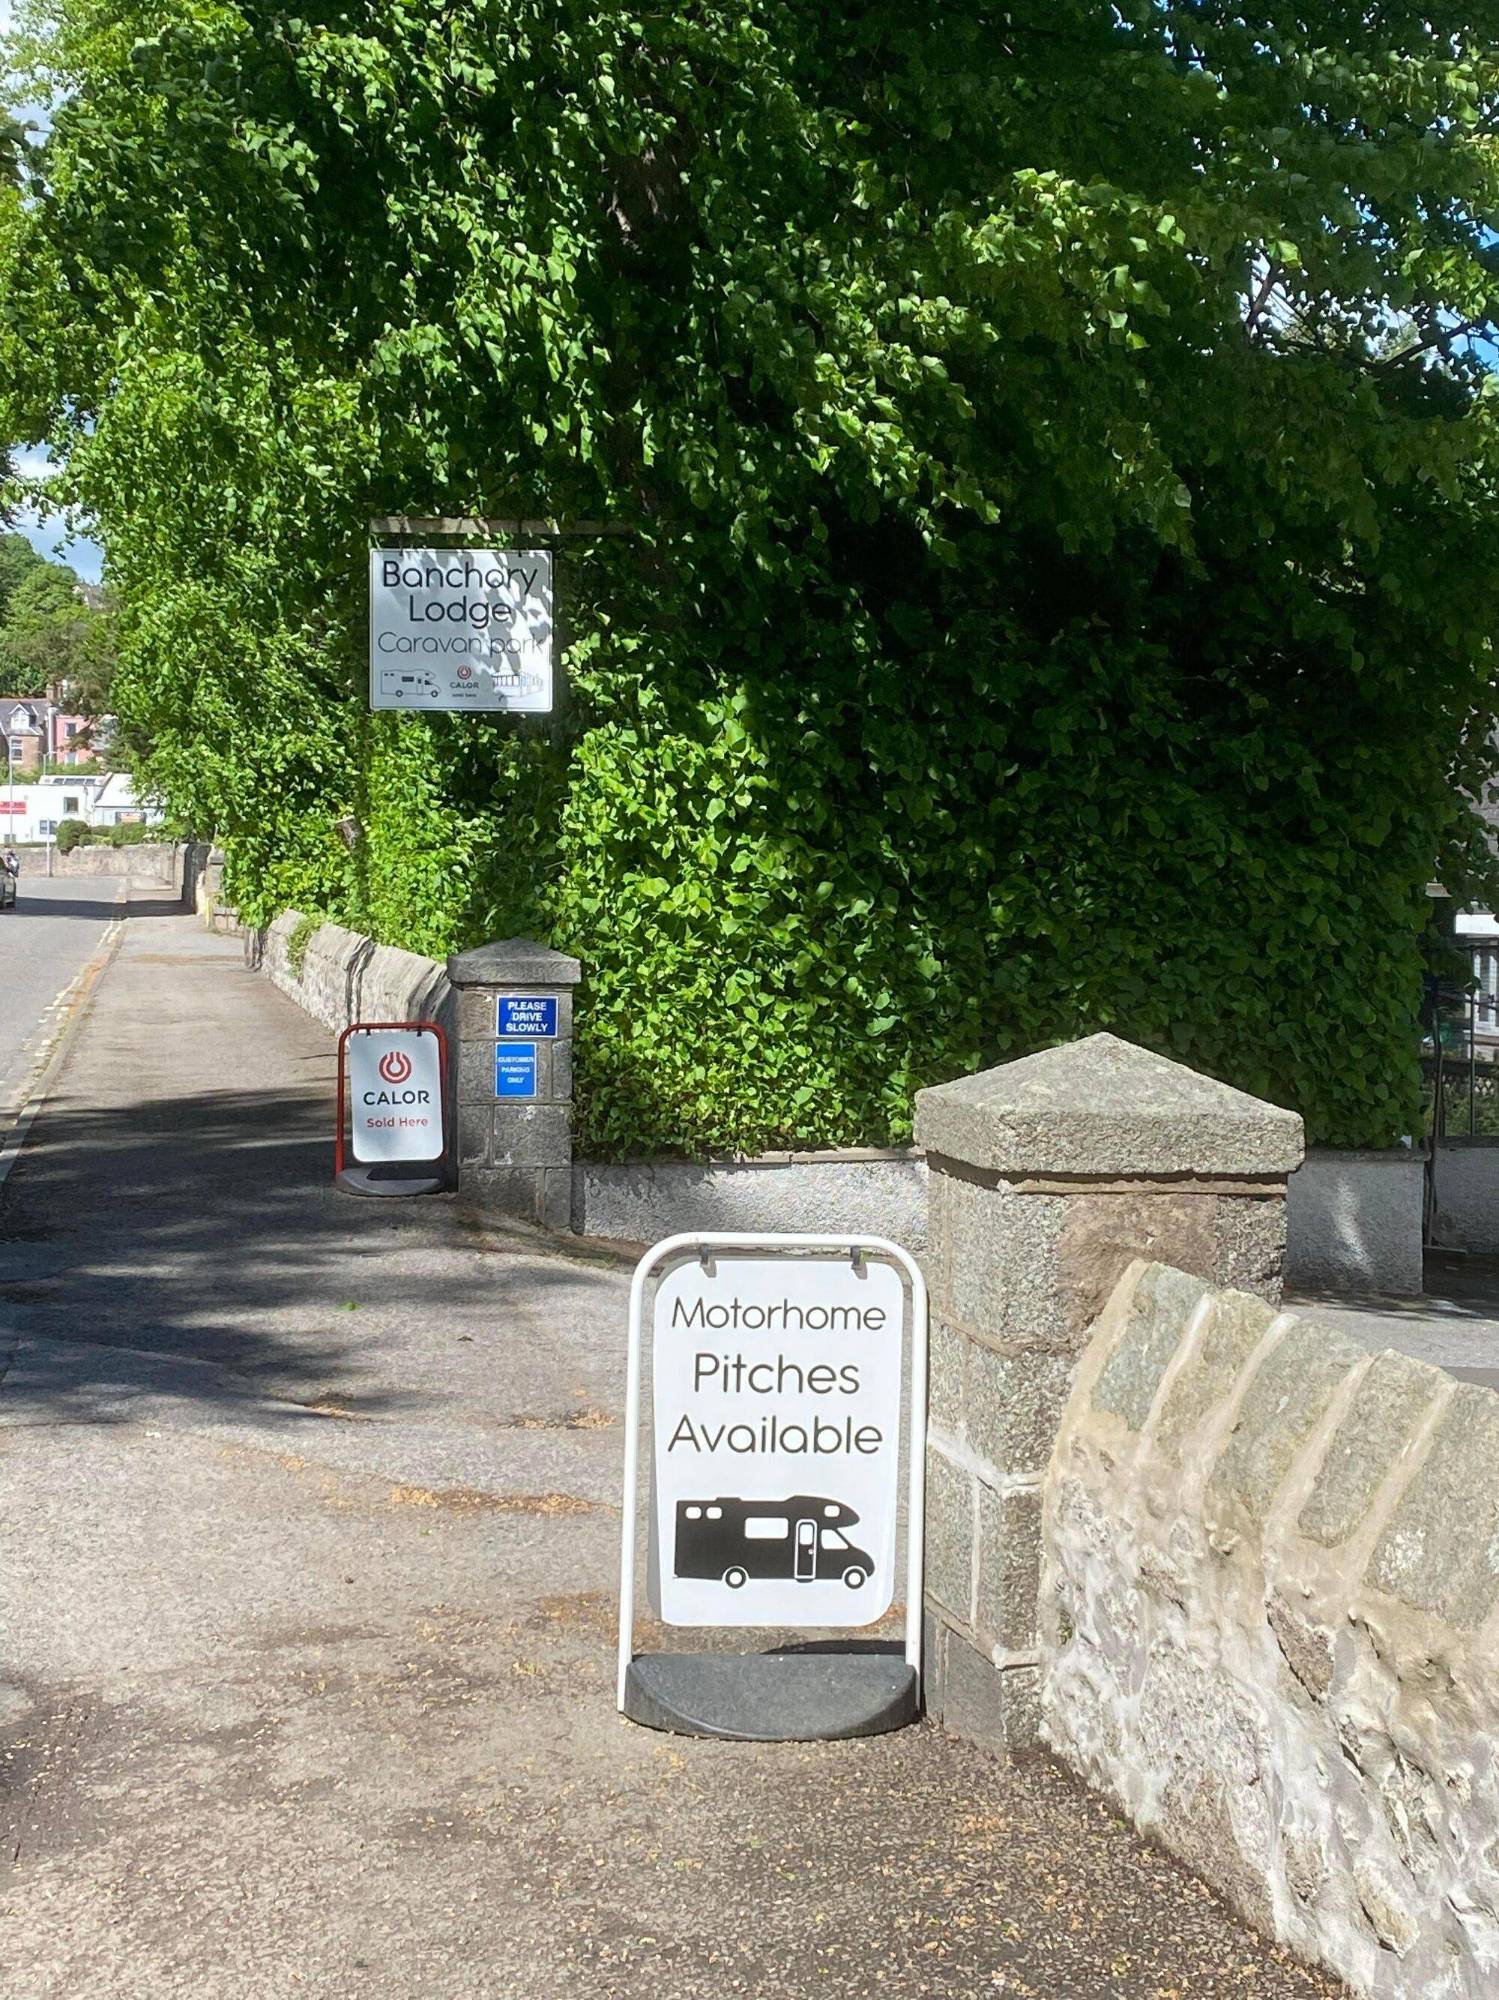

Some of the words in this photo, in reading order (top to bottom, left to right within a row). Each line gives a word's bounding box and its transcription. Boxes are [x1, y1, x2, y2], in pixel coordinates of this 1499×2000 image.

[383, 560, 538, 595] Banchory
[410, 595, 511, 629] Lodge
[377, 631, 483, 654] Caravan
[508, 1002, 547, 1011] PLEASE
[512, 1012, 543, 1021] DRIVE
[506, 1023, 548, 1032] SLOWLY
[363, 1090, 430, 1105] CALOR
[366, 1117, 395, 1128] Sold
[399, 1117, 429, 1127] Here
[671, 1296, 887, 1332] Motorhome
[693, 1353, 861, 1395] Pitches
[667, 1414, 884, 1455] Available
